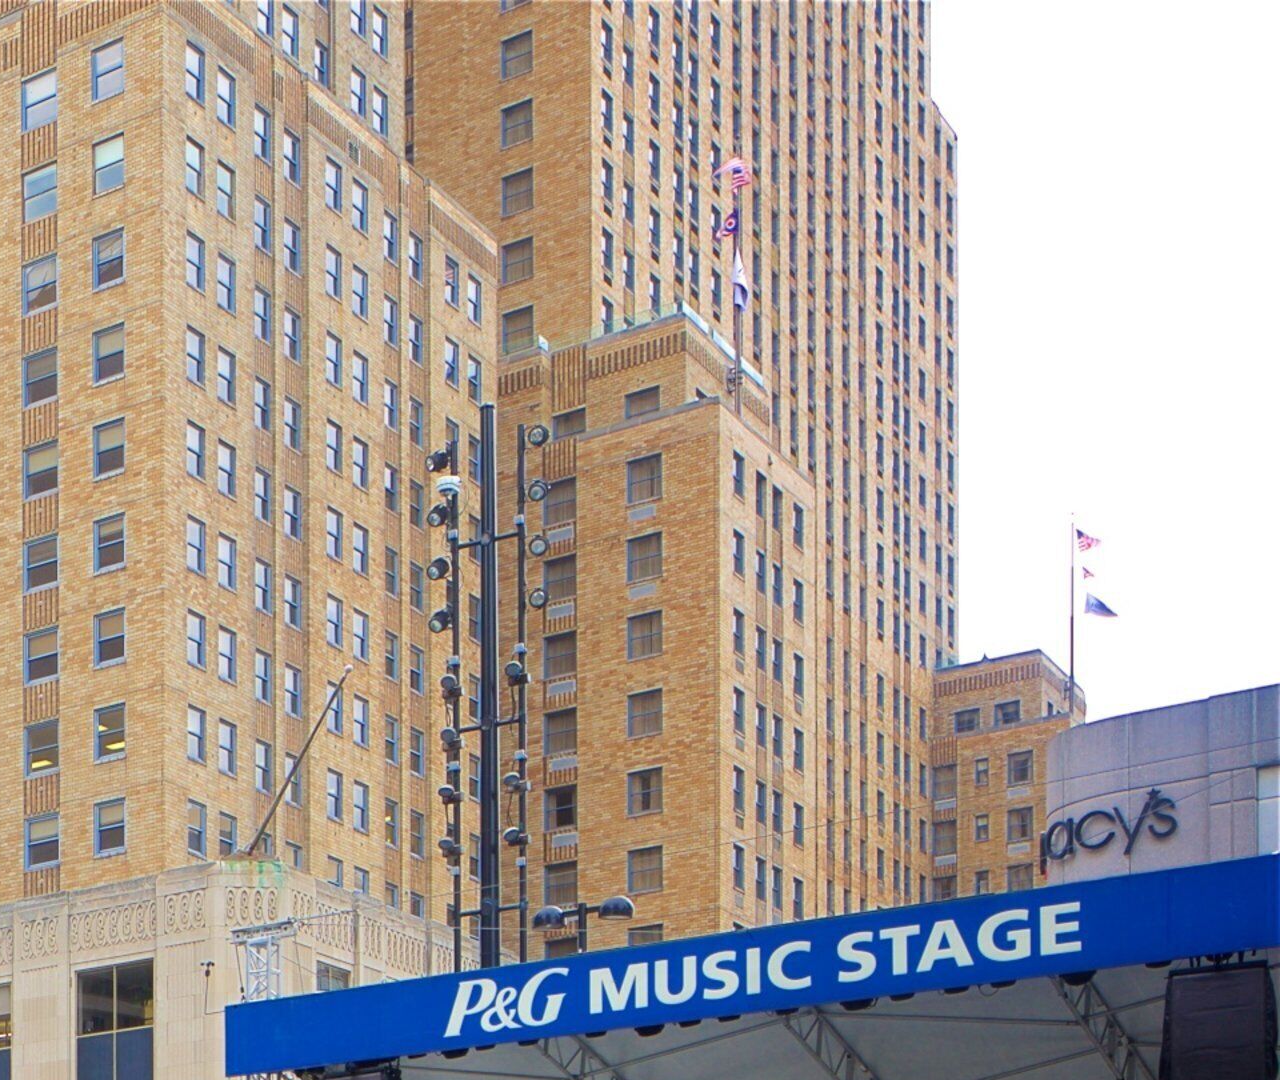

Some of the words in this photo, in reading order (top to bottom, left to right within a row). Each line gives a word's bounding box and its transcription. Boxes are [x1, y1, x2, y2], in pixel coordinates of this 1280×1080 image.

[1041, 790, 1178, 868] acy's
[444, 967, 570, 1038] P&G
[589, 940, 812, 1014] MUSIC
[837, 901, 1083, 984] STAGE
